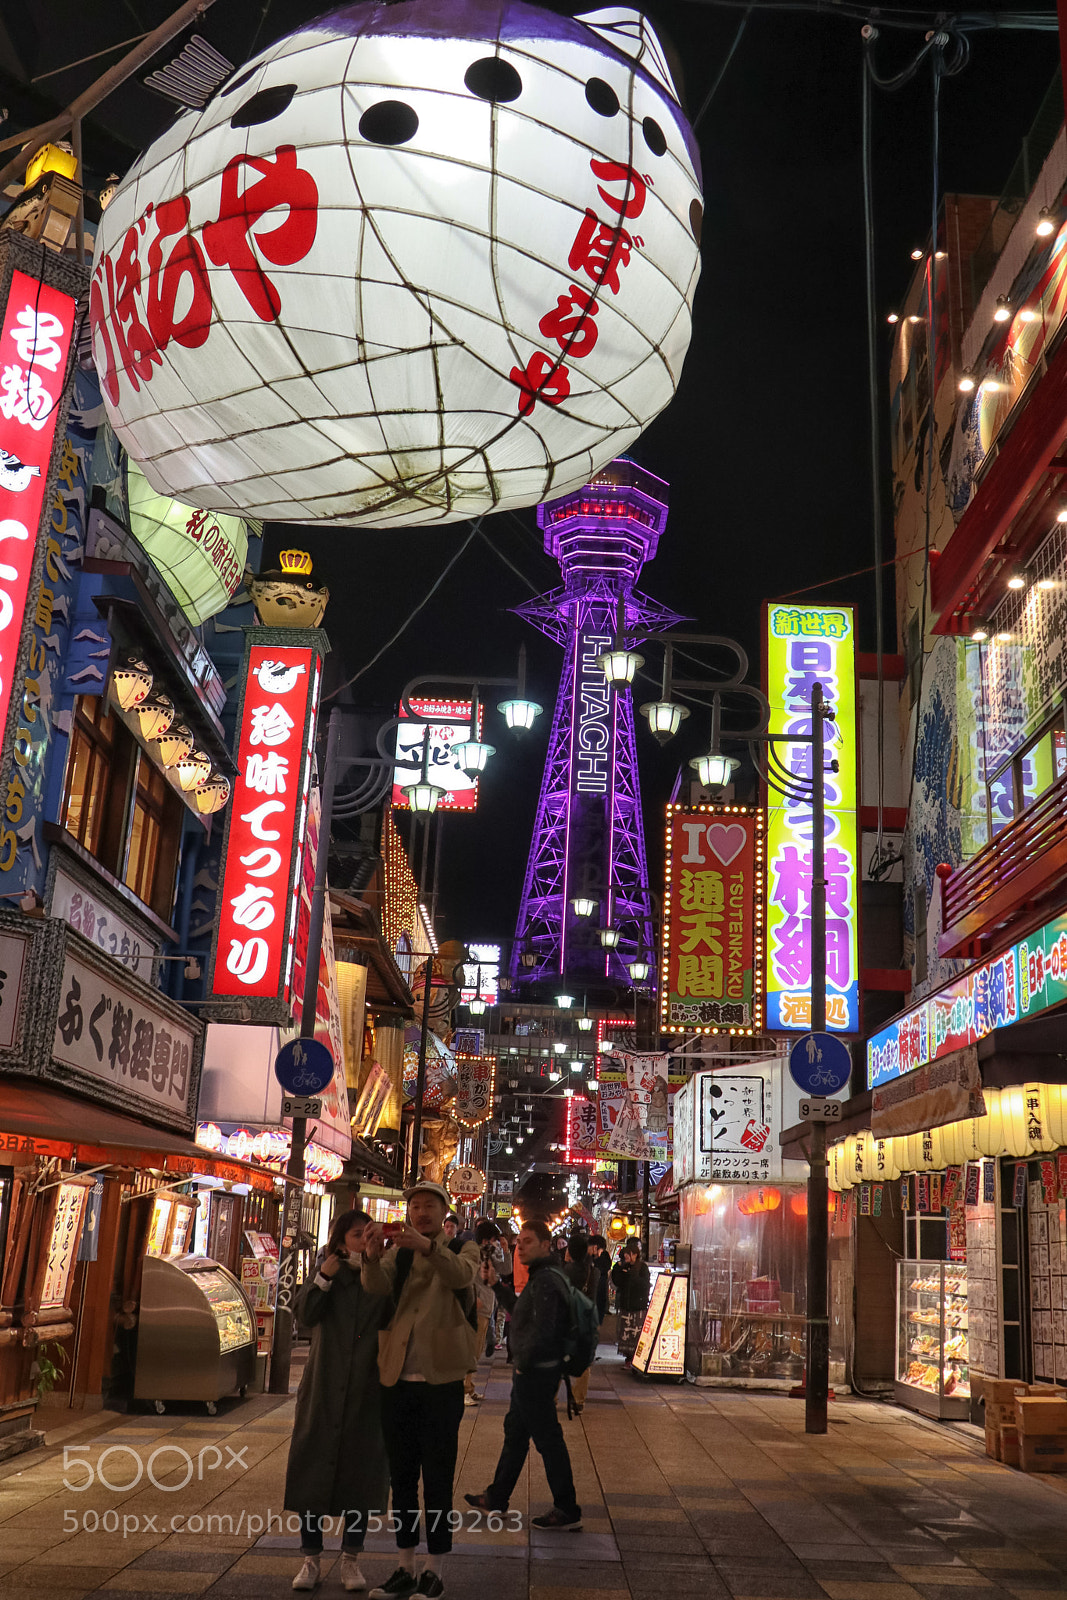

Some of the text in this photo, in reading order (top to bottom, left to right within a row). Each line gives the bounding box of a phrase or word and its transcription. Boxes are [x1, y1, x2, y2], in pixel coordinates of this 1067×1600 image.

[89, 144, 318, 407] づぼらや
[510, 158, 654, 417] づぼらや
[774, 610, 847, 637] 新世界
[577, 635, 612, 792] HITACHI
[681, 823, 707, 864] I
[677, 869, 726, 998] 通天閣
[728, 871, 744, 998] TSUTENKAKU
[283, 1101, 320, 1115] 9-22
[581, 1103, 597, 1146] 串かつ
[801, 1104, 839, 1117] 9-22
[701, 1157, 769, 1168] 1F カウンター席
[701, 1169, 769, 1180] 2F 座敷あります
